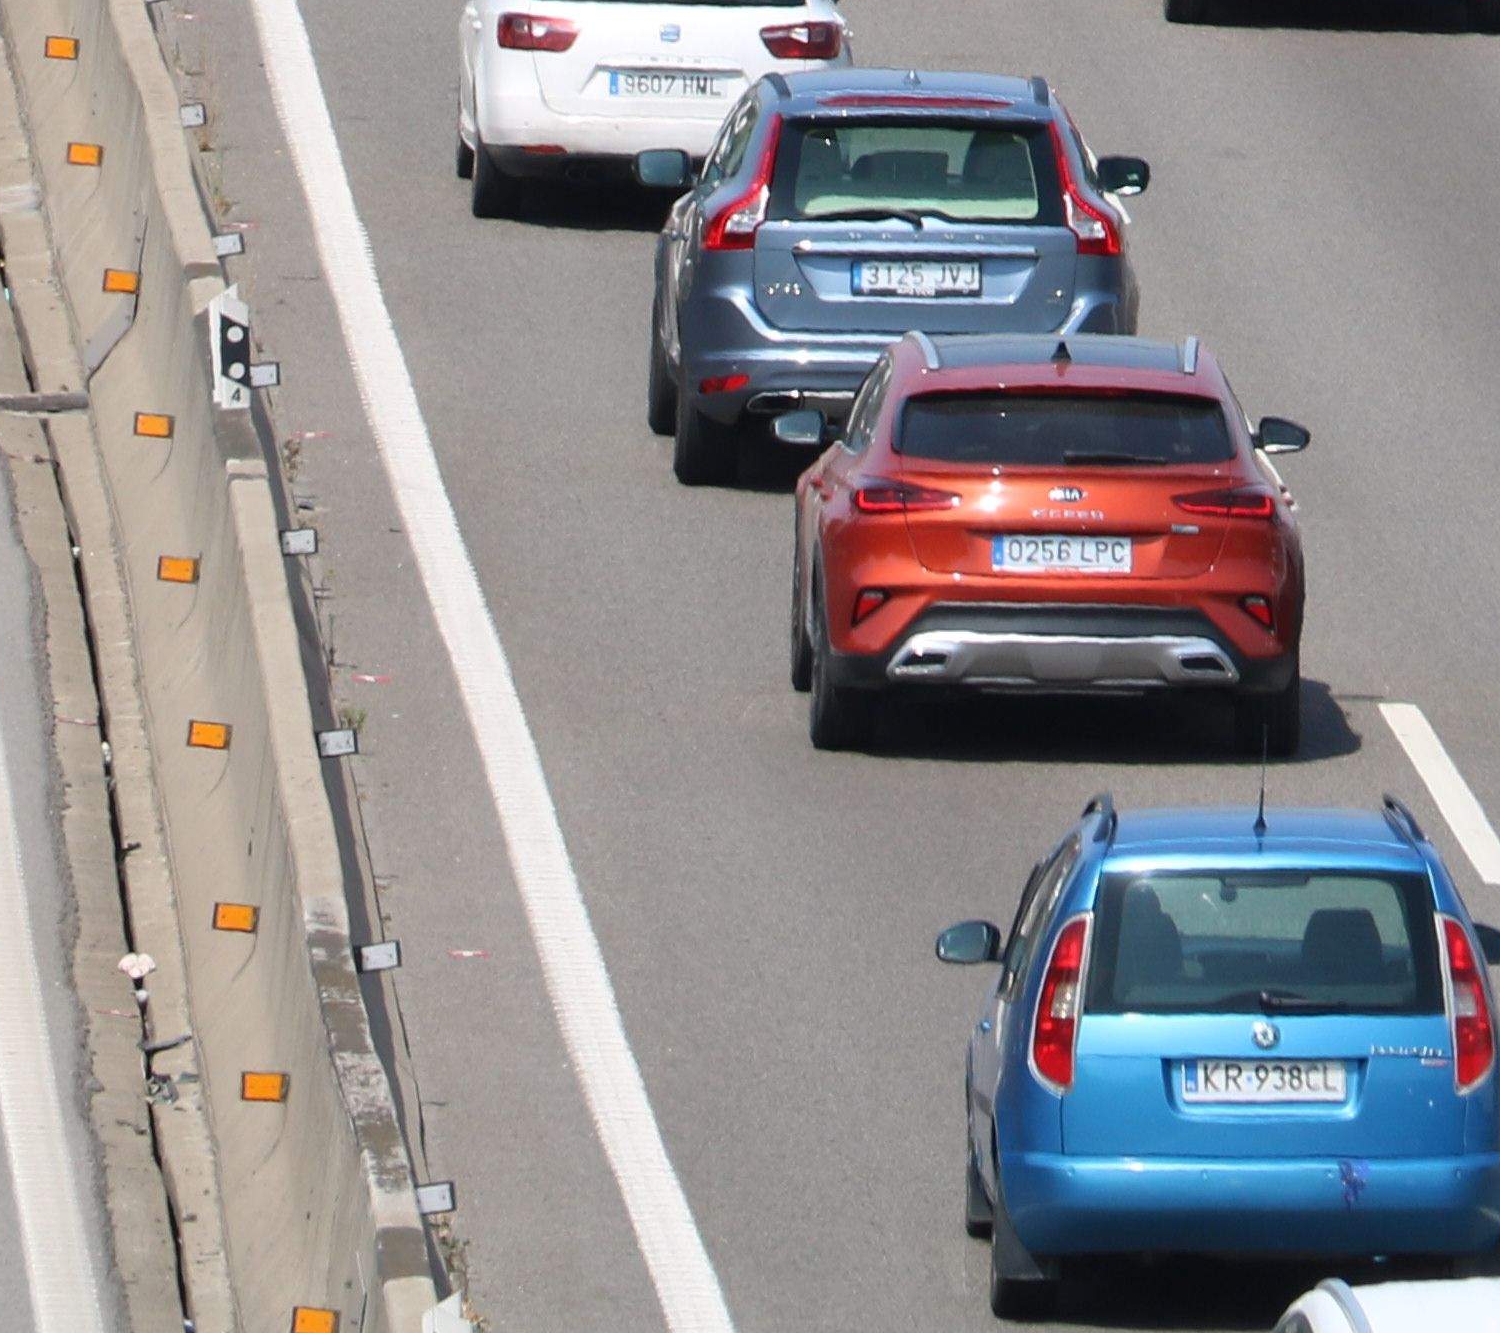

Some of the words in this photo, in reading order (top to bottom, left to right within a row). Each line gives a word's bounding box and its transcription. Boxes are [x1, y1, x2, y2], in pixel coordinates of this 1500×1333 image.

[624, 75, 677, 95] 9607
[867, 264, 925, 286] 3125
[940, 264, 980, 286] JVJ
[231, 388, 242, 403] 4
[1007, 539, 1074, 563] 0256
[1079, 539, 1127, 564] LPC
[1202, 1063, 1244, 1093] KR
[1254, 1062, 1339, 1094] 938CL
